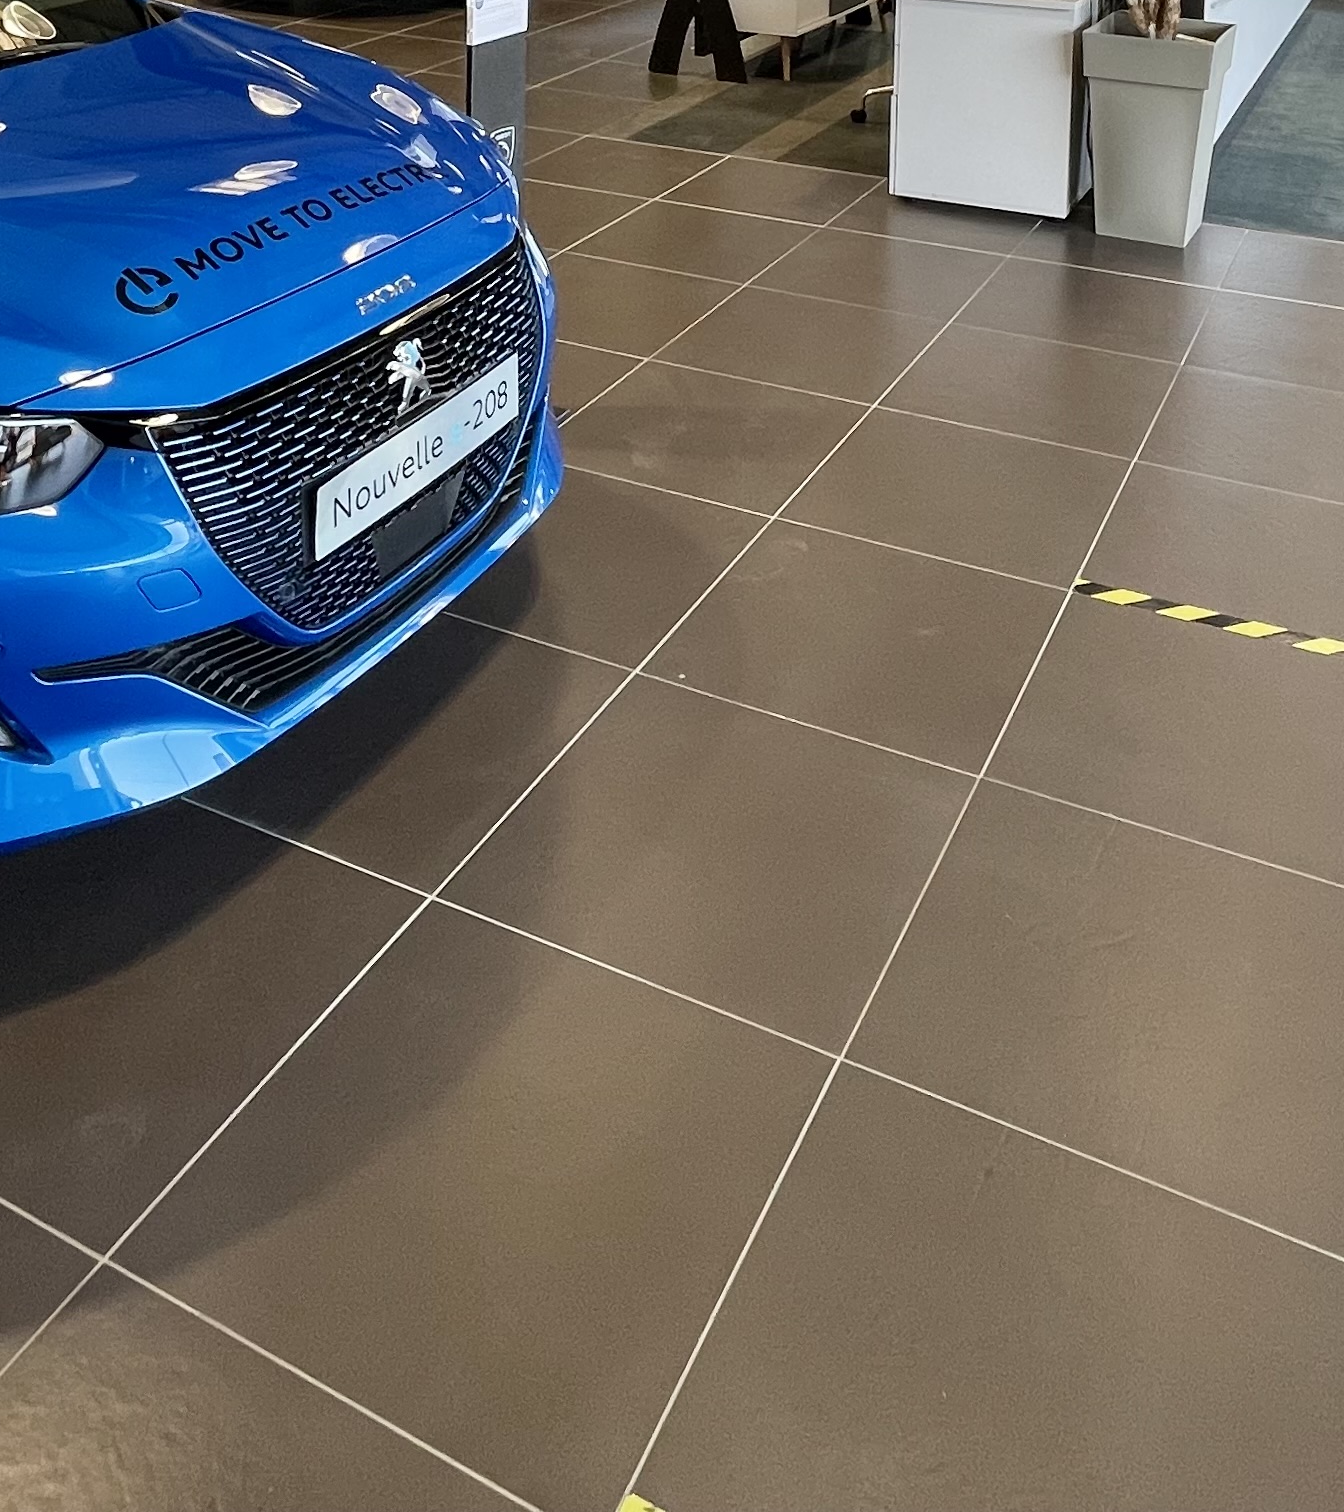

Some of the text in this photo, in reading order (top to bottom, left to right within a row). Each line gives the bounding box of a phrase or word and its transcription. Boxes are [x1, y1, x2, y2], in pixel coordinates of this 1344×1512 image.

[173, 216, 290, 281] MOVE
[279, 199, 333, 229] TO
[332, 434, 444, 528] Nouvelle
